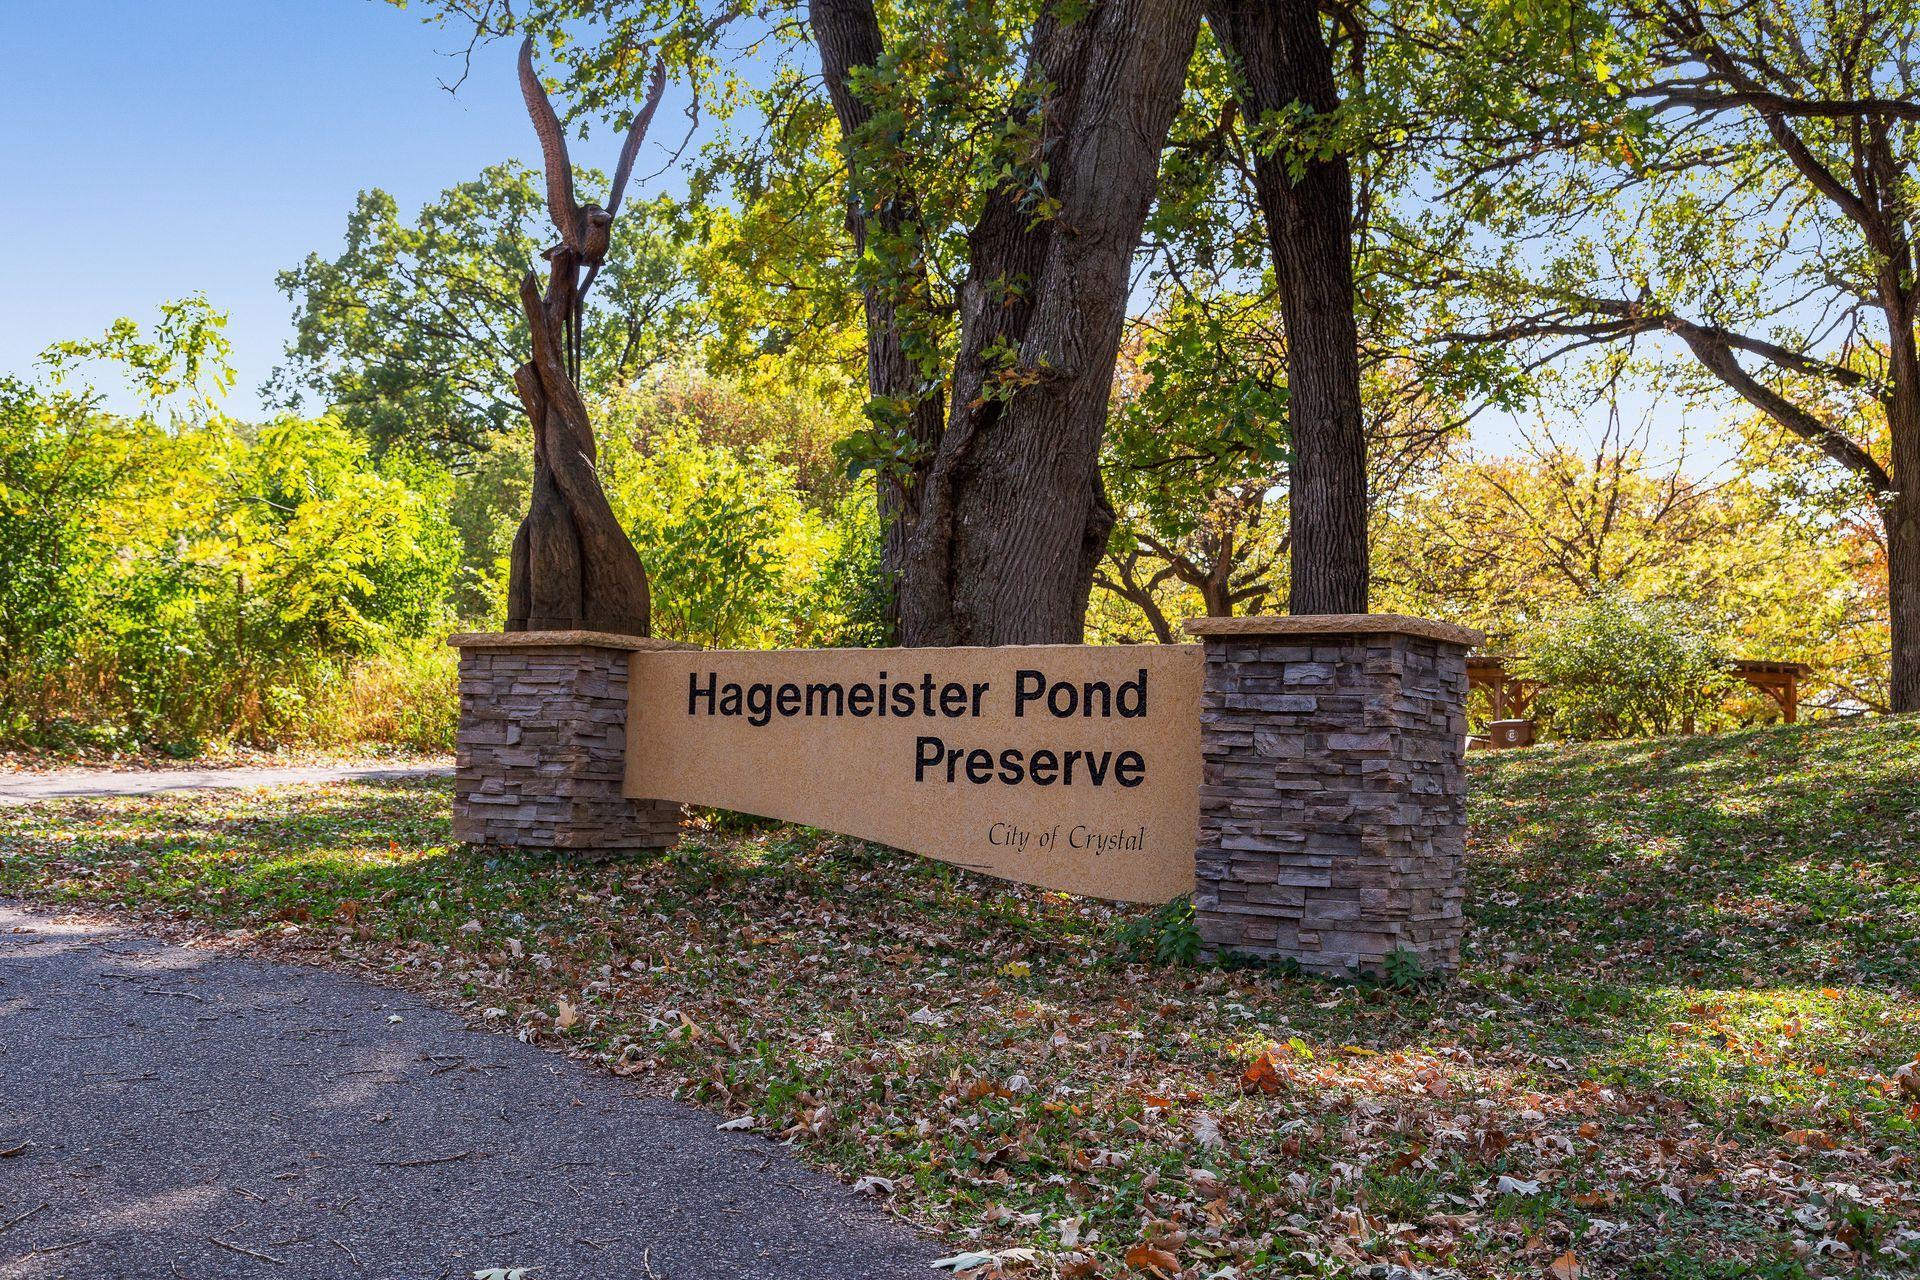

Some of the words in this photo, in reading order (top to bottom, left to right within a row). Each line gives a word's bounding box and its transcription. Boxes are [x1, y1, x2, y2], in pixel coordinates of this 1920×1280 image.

[688, 671, 989, 727] Hagemeister
[1014, 668, 1148, 719] Pond
[915, 736, 1146, 788] Preserve
[988, 822, 1030, 852] City
[1038, 824, 1060, 852] of
[1069, 825, 1144, 855] Crystal
